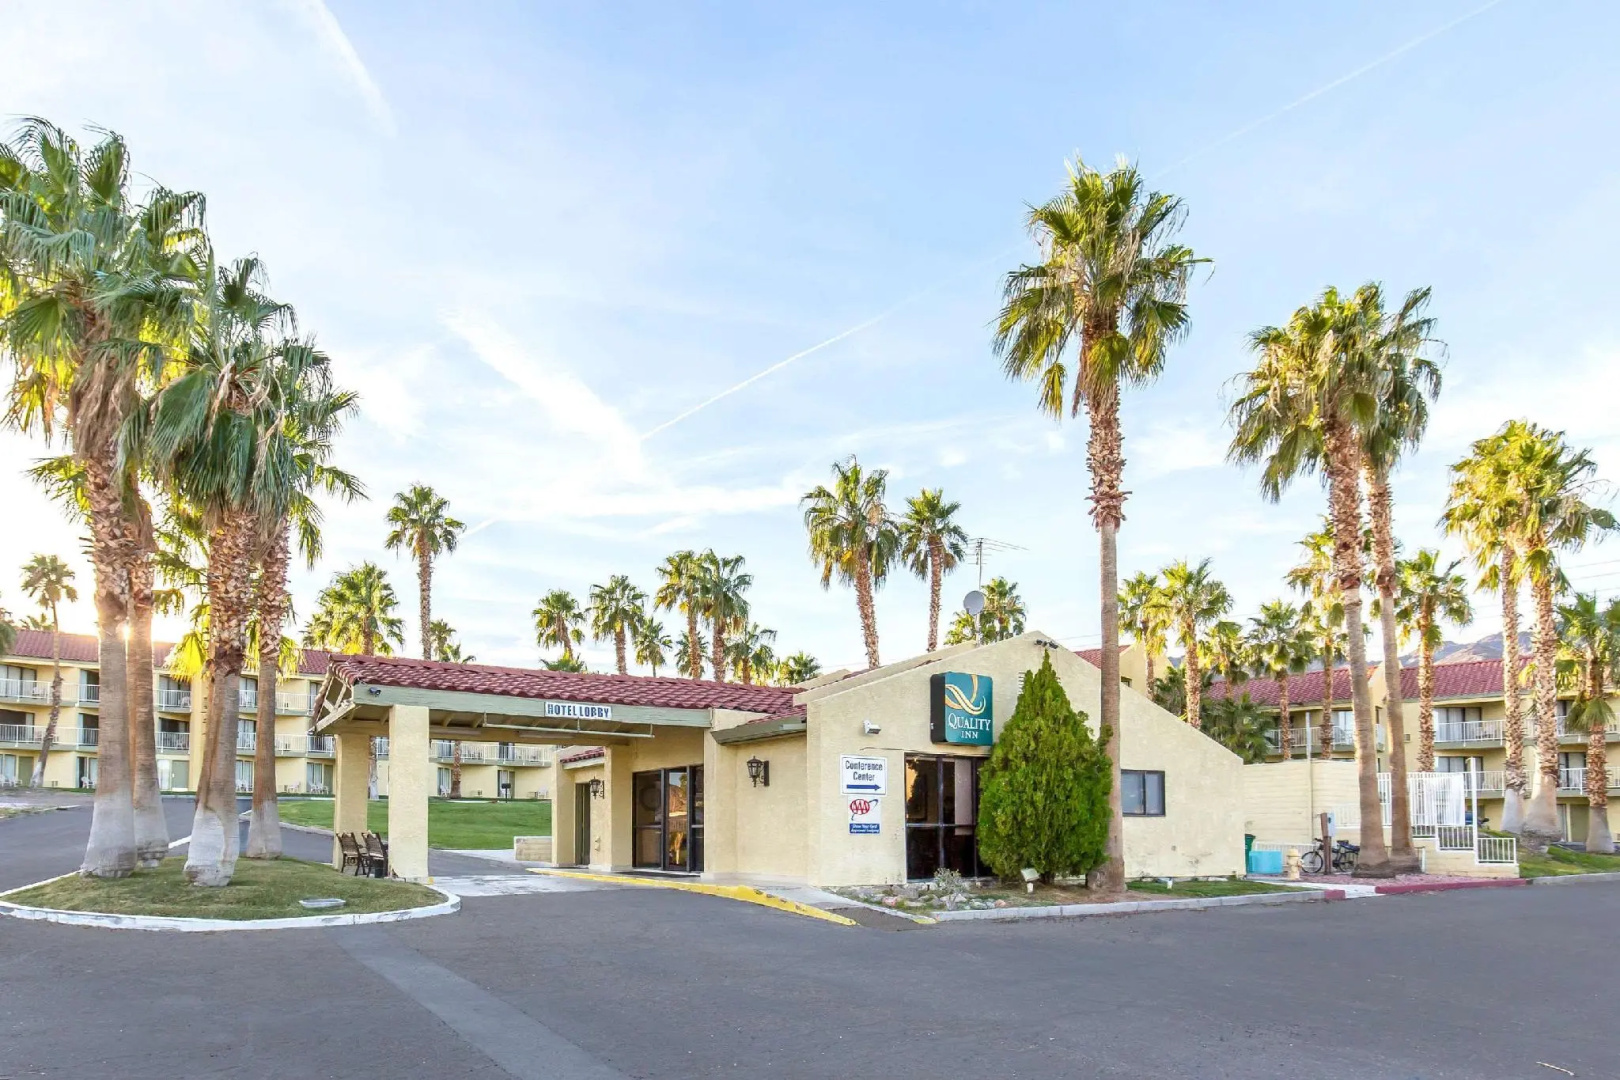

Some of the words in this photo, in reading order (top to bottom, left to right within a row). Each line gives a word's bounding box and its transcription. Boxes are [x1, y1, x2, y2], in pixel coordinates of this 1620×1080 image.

[547, 703, 577, 716] HOTEL
[579, 706, 609, 718] LOBBY
[948, 712, 991, 731] QUALITY
[961, 730, 979, 739] INN
[845, 760, 883, 771] Conference
[853, 771, 875, 781] Center
